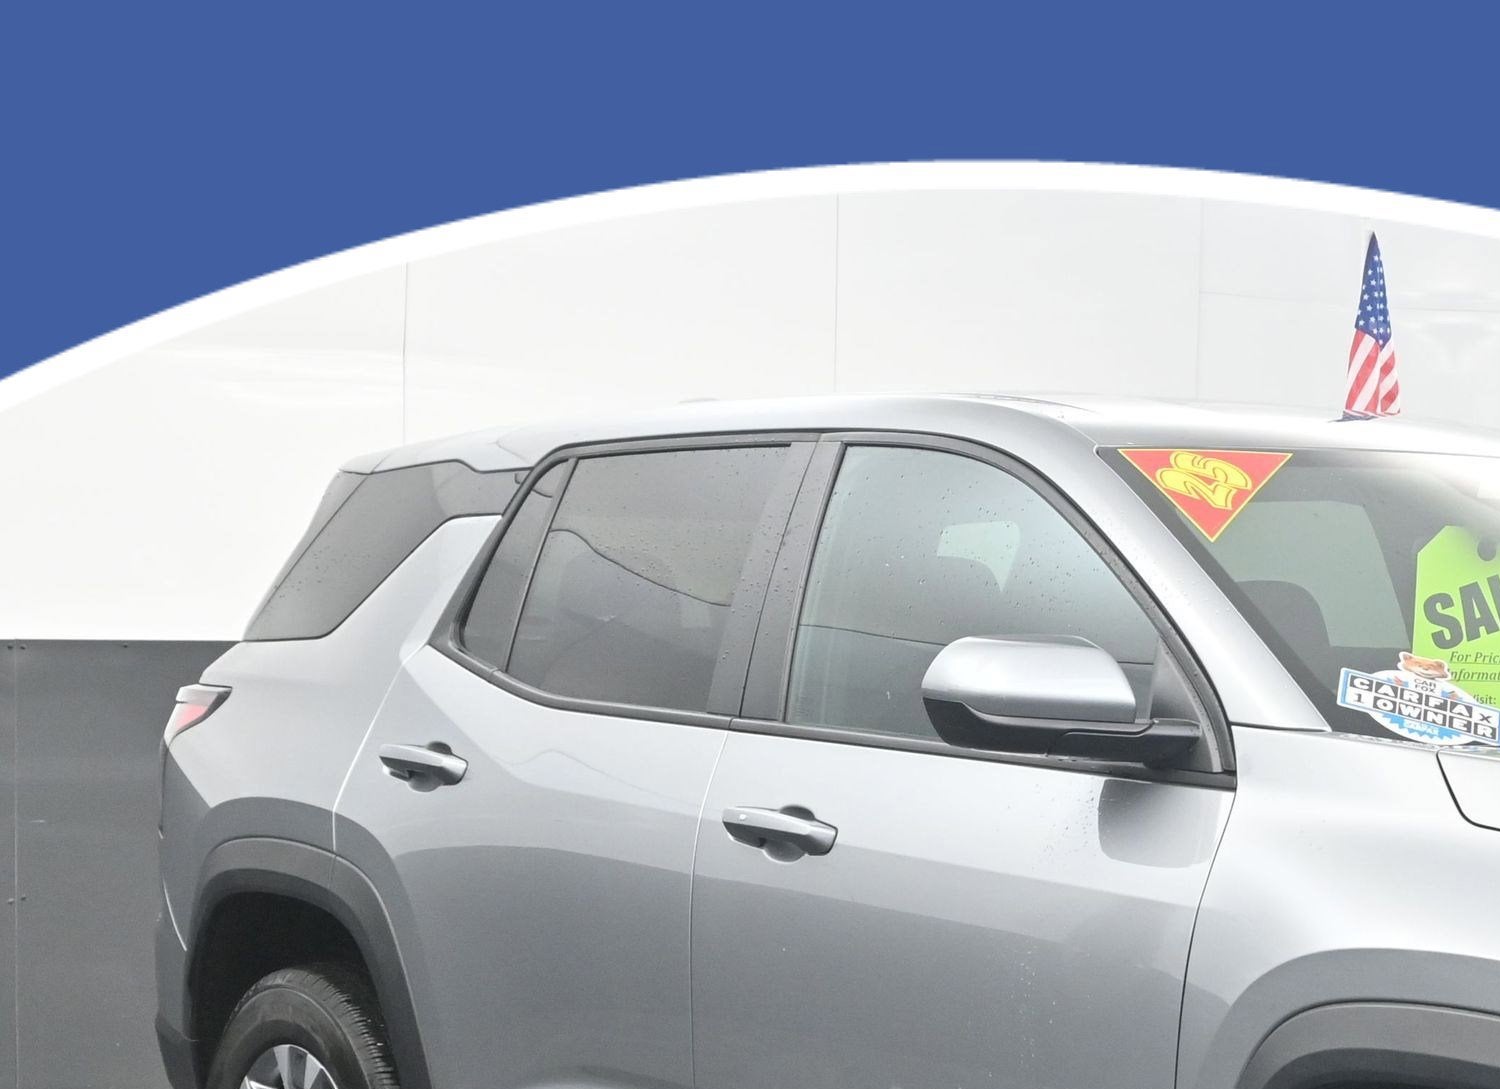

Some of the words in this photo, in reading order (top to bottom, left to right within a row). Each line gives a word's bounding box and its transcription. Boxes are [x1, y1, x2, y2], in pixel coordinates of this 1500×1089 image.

[1450, 651, 1471, 662] For
[1352, 676, 1494, 724] CARFAX
[1353, 690, 1367, 704] 1
[1375, 699, 1495, 739] OWNER
